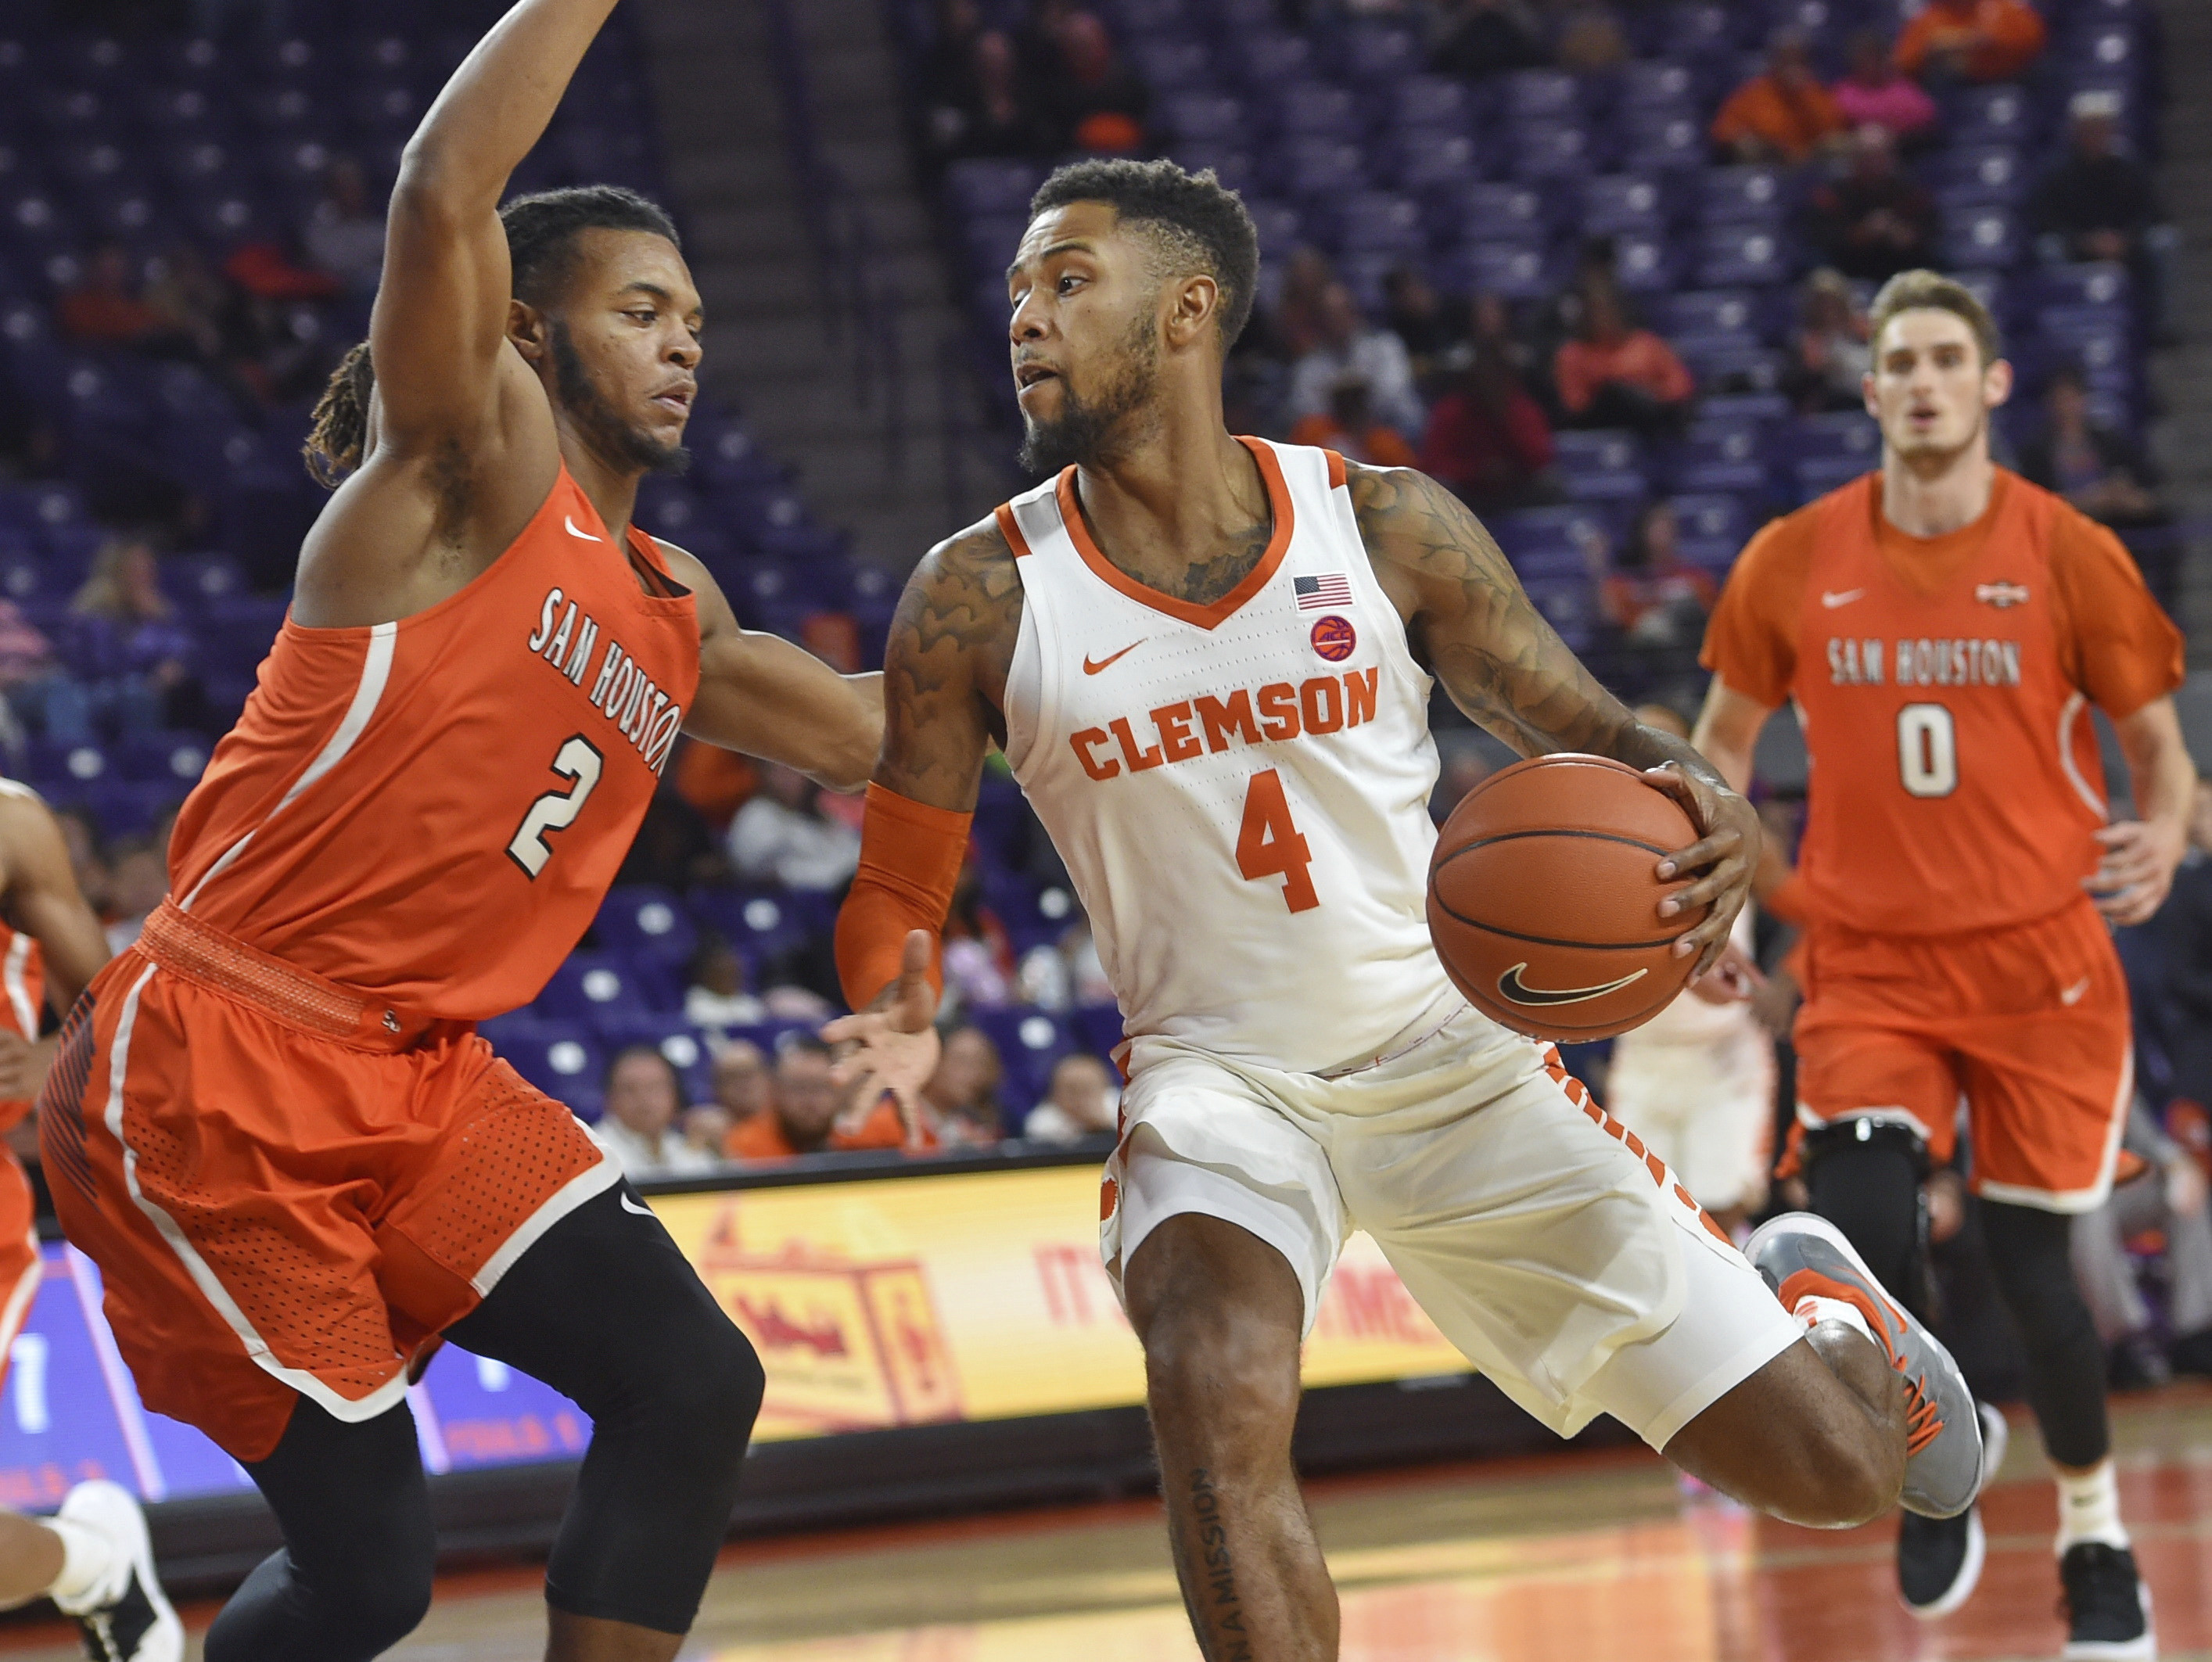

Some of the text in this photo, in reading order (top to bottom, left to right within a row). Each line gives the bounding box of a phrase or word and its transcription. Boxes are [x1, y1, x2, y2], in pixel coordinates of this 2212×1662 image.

[529, 587, 599, 686] SAM
[1828, 637, 2020, 686] SAM HOUSTON
[1069, 667, 1378, 781] CLEMSON
[1897, 702, 1957, 798] 0
[505, 734, 601, 880] 2
[1235, 769, 1320, 914] 4
[1189, 1468, 1238, 1605] MISSION
